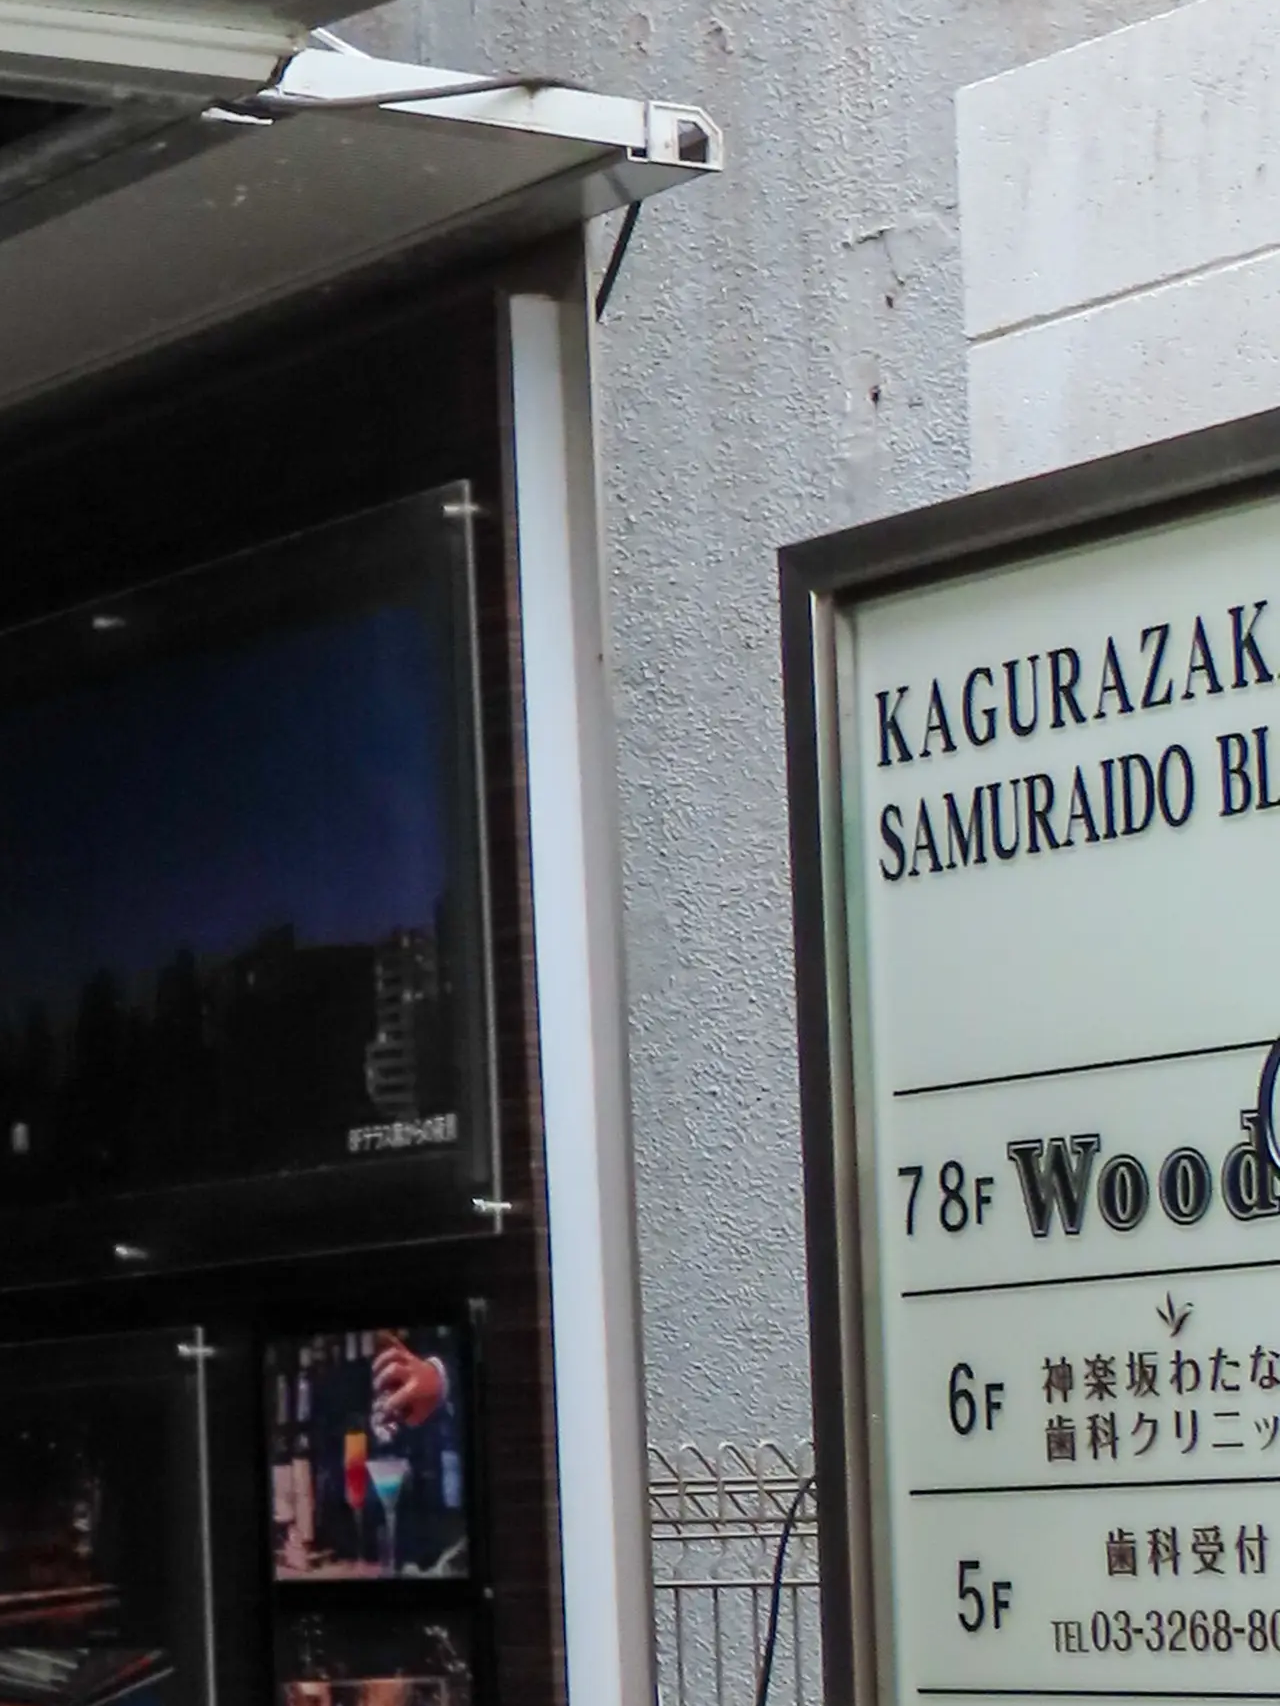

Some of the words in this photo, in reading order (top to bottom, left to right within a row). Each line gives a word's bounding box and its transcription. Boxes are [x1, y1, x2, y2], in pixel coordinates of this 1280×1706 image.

[875, 600, 1280, 767] KAGURAZAK
[880, 744, 1194, 881] SAMURAIDO
[949, 1363, 1004, 1435] 6F
[1106, 1524, 1269, 1576] 歯科受付
[957, 1561, 1012, 1632] 5F
